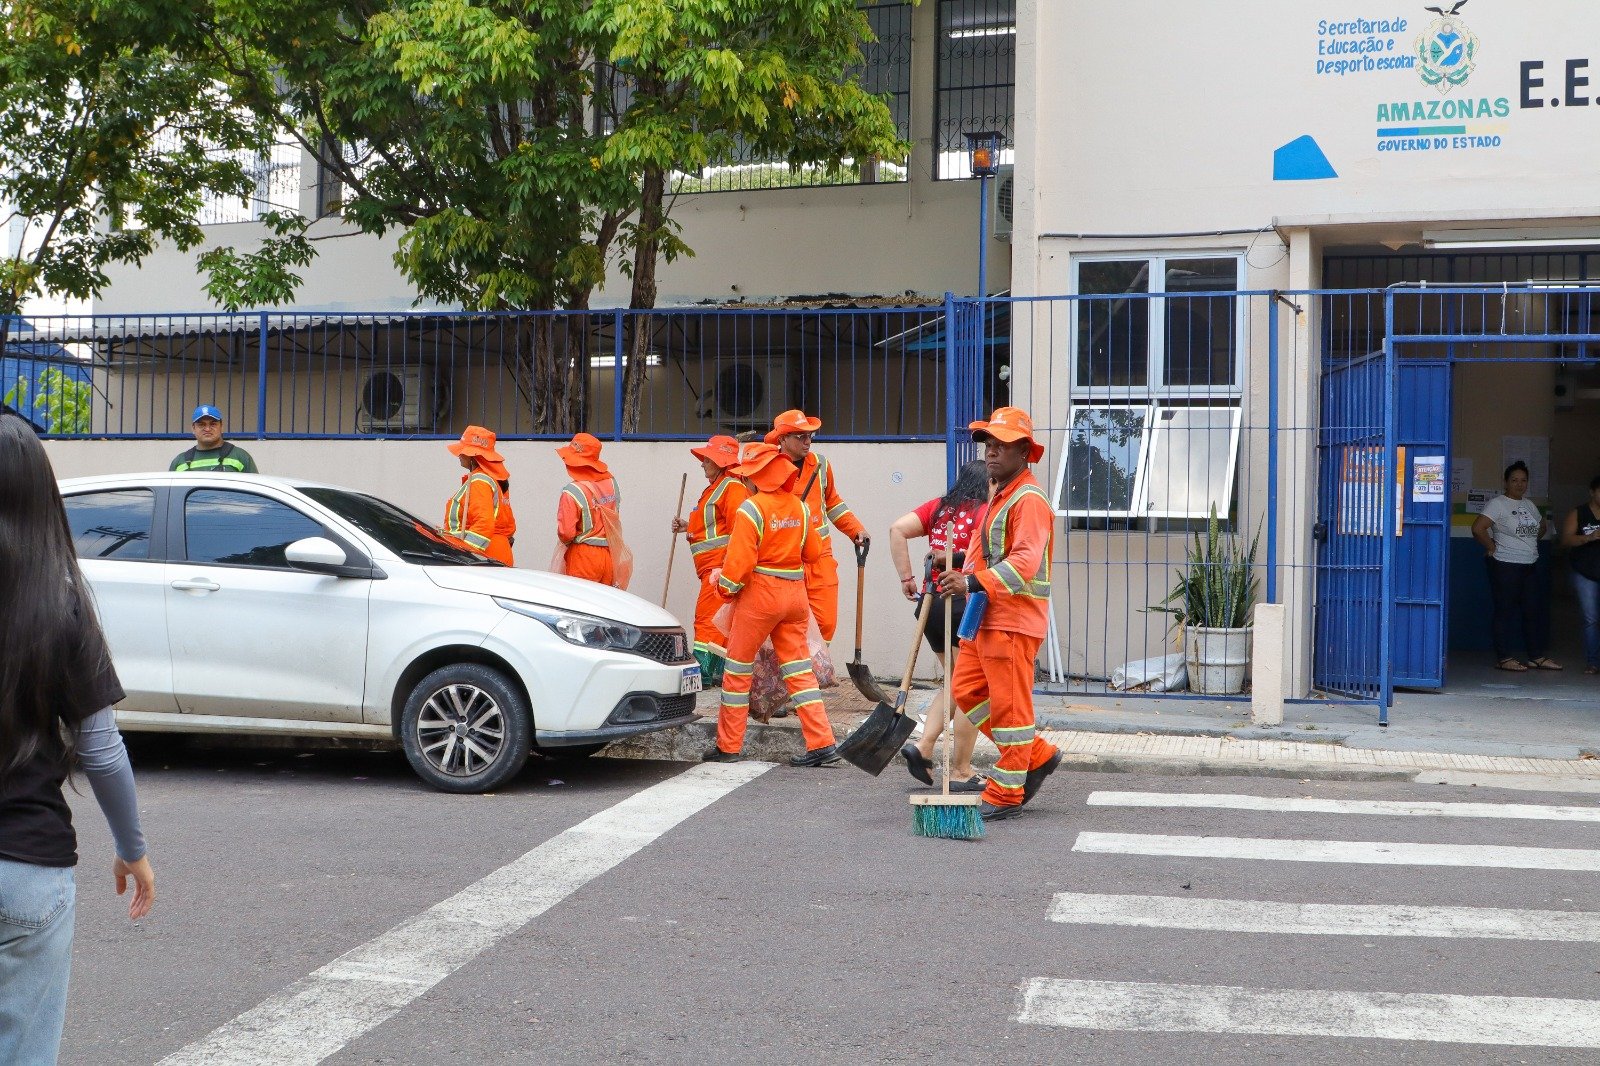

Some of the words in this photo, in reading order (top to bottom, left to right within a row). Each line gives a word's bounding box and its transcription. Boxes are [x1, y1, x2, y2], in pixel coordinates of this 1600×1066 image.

[1319, 36, 1383, 55] Educação
[1386, 38, 1395, 51] e
[1316, 55, 1375, 76] Desporto
[1376, 97, 1510, 122] AMAZONAS
[1377, 138, 1431, 151] GOVERNO
[1433, 137, 1449, 150] DO
[1452, 135, 1501, 149] ESTADO
